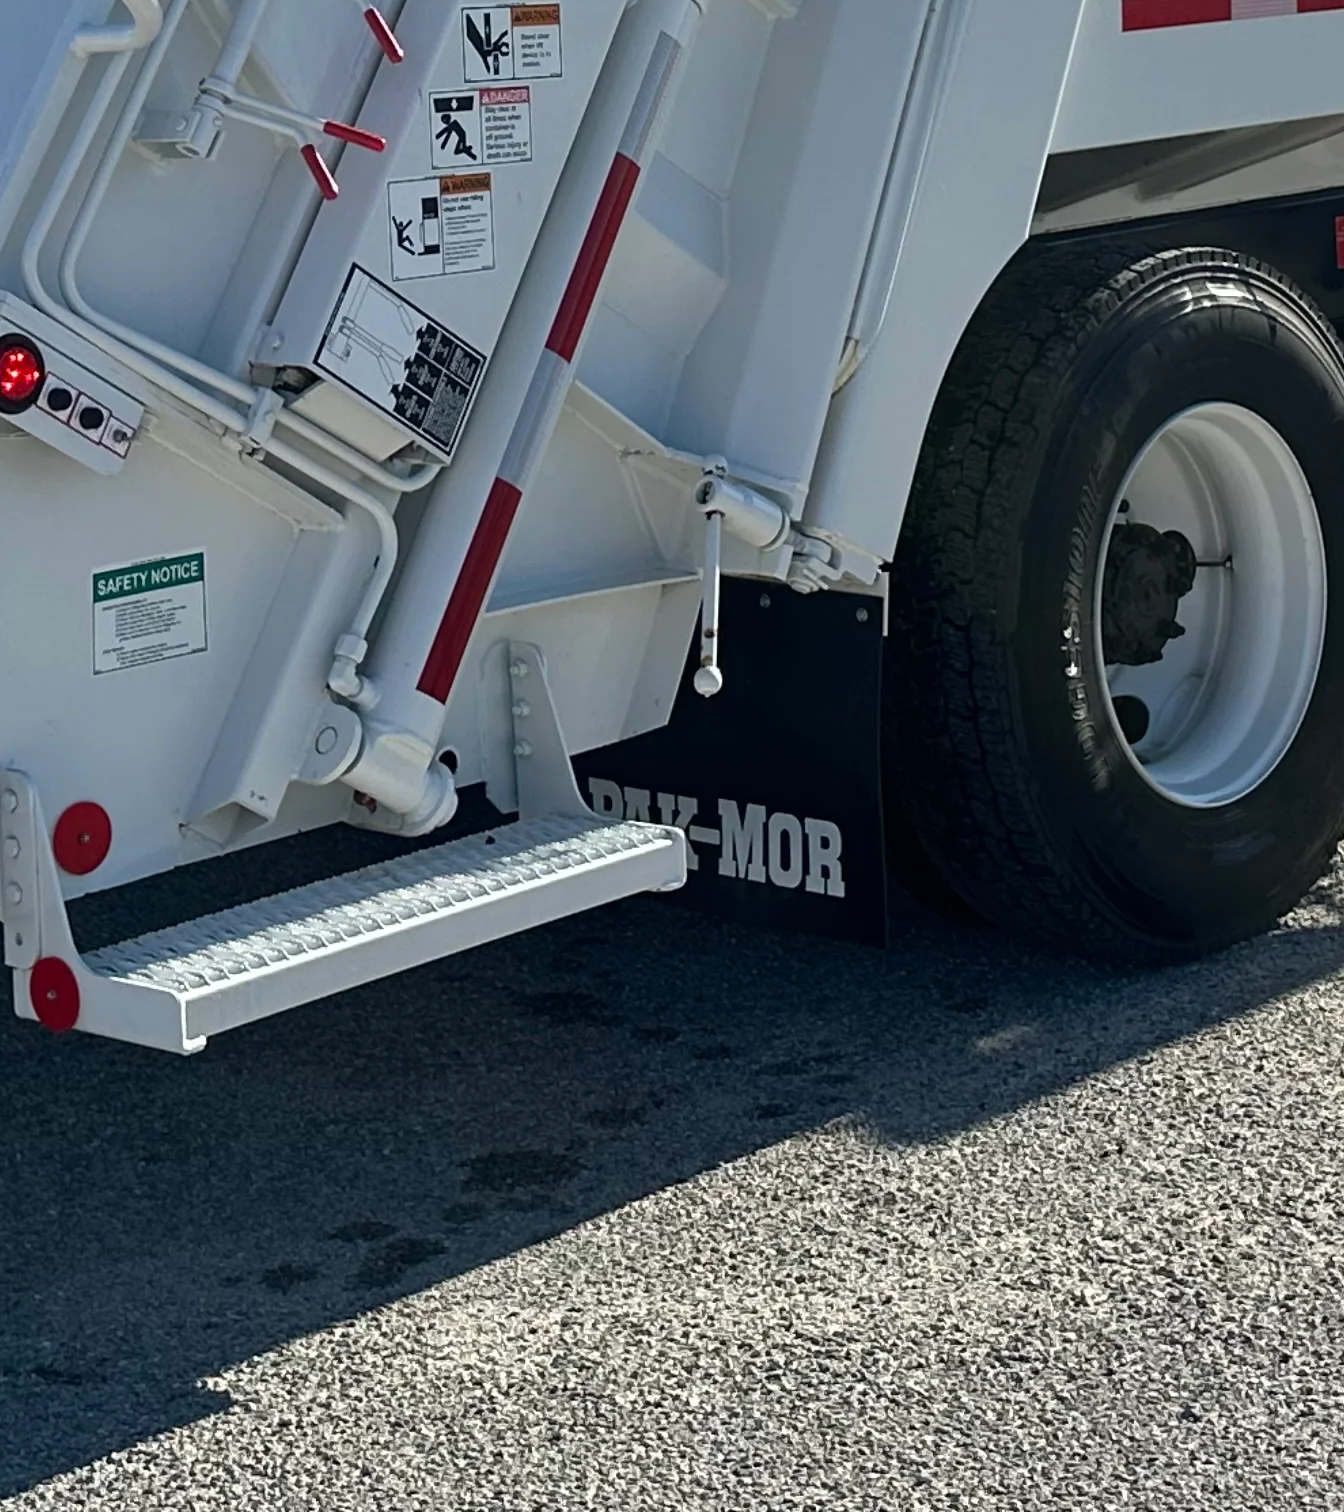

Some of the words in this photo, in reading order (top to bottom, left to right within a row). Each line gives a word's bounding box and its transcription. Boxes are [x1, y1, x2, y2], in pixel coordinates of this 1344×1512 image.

[490, 89, 529, 103] DANGER
[97, 571, 148, 596] SAFETY
[151, 561, 199, 585] NOTICE
